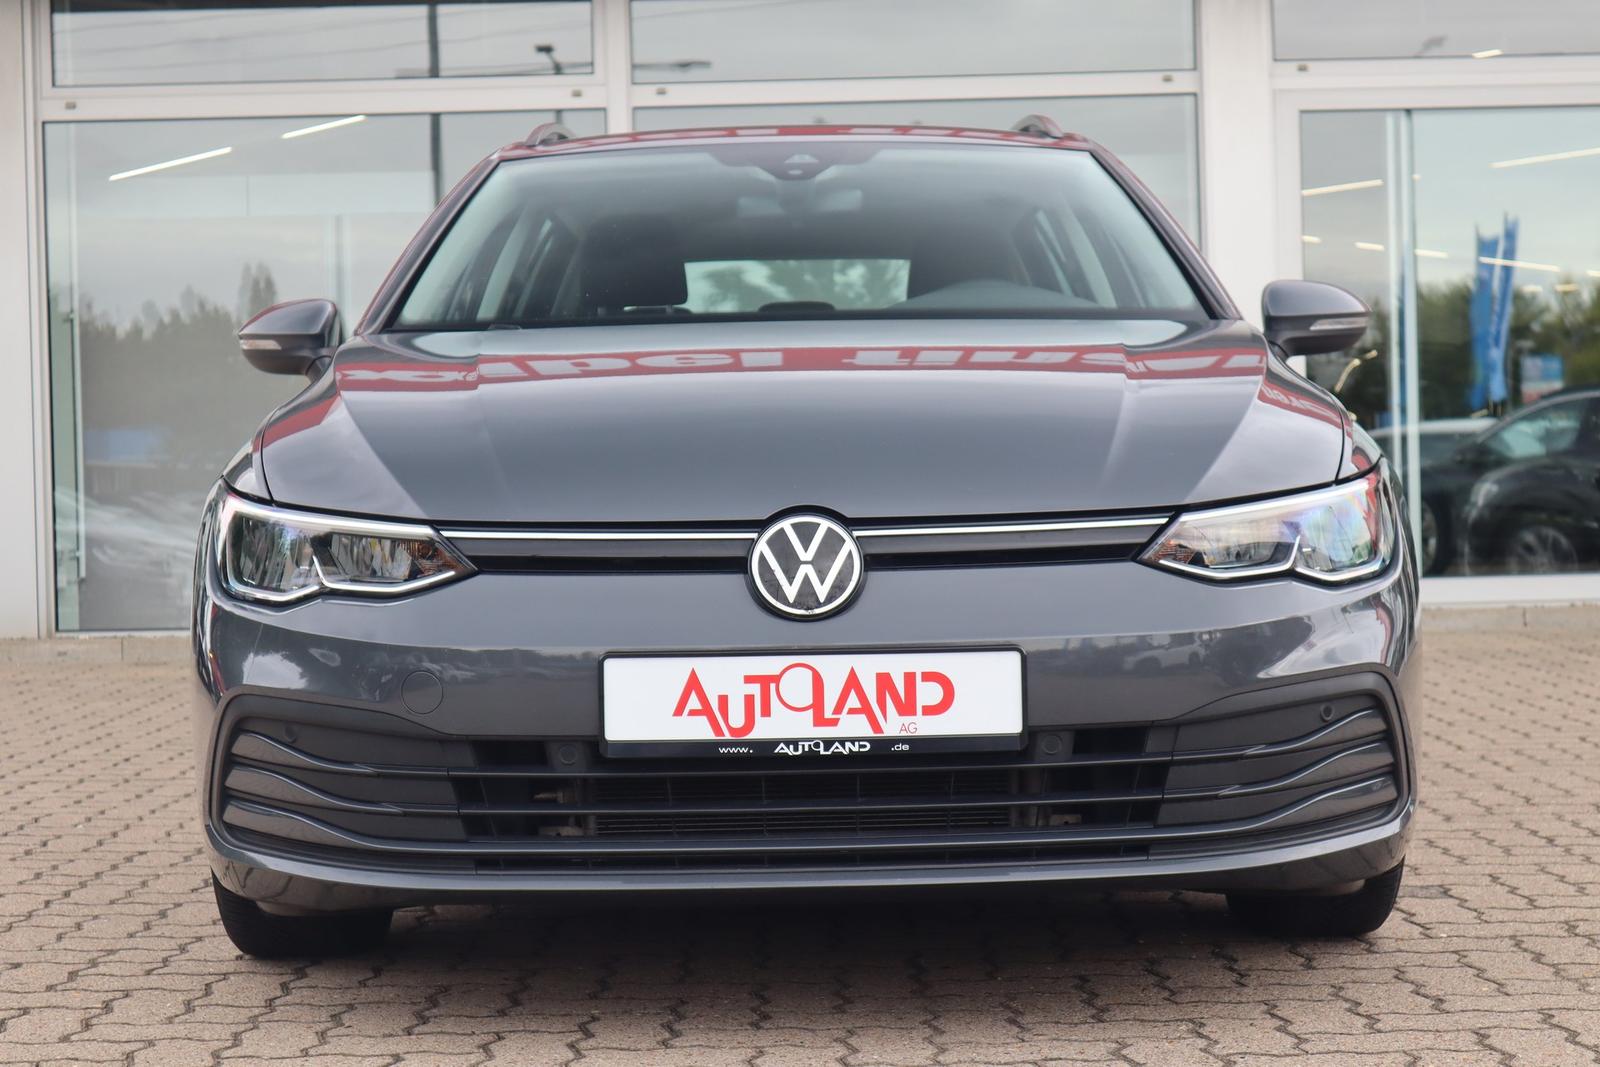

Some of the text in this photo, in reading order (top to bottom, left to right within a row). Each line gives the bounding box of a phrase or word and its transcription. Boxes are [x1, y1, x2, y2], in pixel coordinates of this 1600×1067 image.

[672, 663, 955, 738] AUTOLAND
[899, 722, 918, 734] AG
[891, 743, 910, 751] .de
